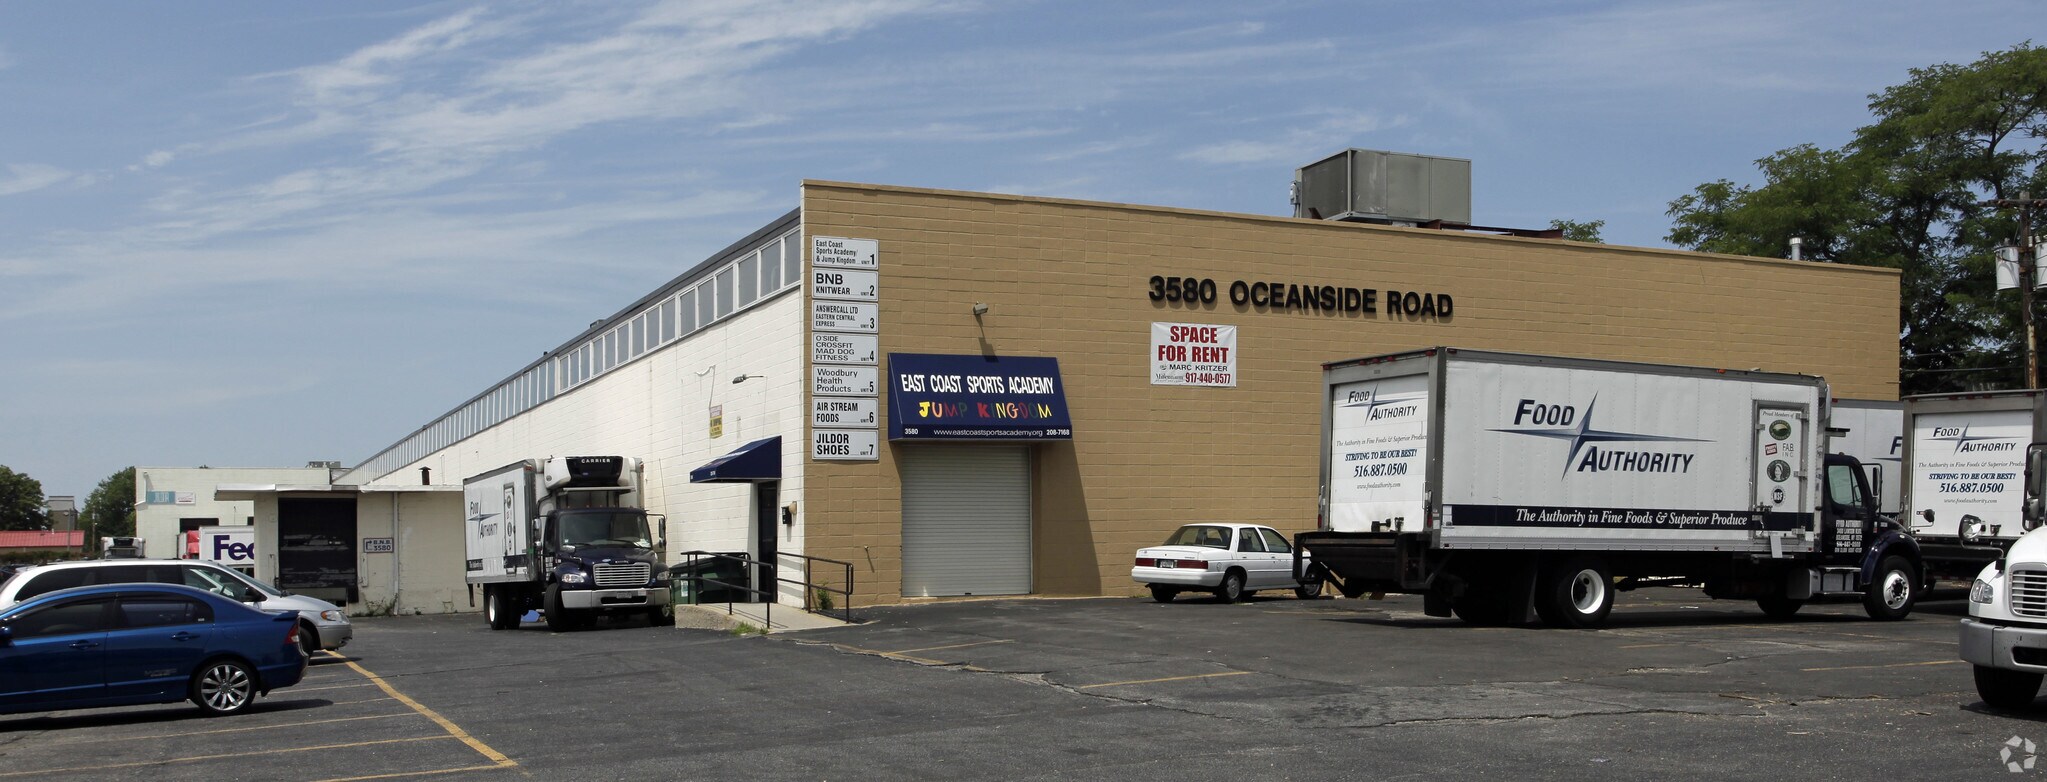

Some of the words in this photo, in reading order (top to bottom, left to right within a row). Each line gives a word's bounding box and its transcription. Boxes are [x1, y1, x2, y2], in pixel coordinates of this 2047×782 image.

[821, 256, 835, 264] Jump
[836, 256, 856, 265] Kingdom
[870, 254, 875, 265] 1
[816, 273, 843, 284] BNB
[816, 286, 850, 295] KNITWEAR
[870, 285, 874, 296] 2
[1149, 275, 1217, 304] 3580
[1230, 280, 1377, 313] OCEANSIDE
[1387, 290, 1454, 318] ROAD
[816, 305, 848, 314] ANSWERCALL
[870, 318, 874, 329] 3
[1170, 326, 1218, 343] SPACE
[870, 351, 874, 361] 4
[1158, 345, 1186, 362] FOR
[1192, 346, 1229, 363] RENT
[817, 368, 858, 378] Woodbury
[869, 381, 874, 392] 5
[901, 374, 926, 392] EAST
[930, 374, 962, 393] COAST
[967, 375, 1004, 394] SPORTS
[1008, 376, 1054, 394] ACADEMY
[1348, 391, 1370, 403] FOOD
[817, 402, 828, 411] AIR
[830, 402, 858, 411] STREAM
[918, 401, 968, 418] JUMP
[977, 402, 1052, 419] KINGDOM
[816, 414, 839, 422] FOODS
[869, 412, 874, 423] 6
[1370, 406, 1417, 420] AUTHORITY
[1513, 399, 1575, 426] FOOD
[1933, 427, 1959, 437] FOOD
[816, 434, 849, 444] JILDOR
[817, 445, 849, 455] SHOES
[869, 444, 874, 455] 7
[1961, 442, 2016, 452] AUTHORITY
[1345, 452, 1369, 461] STRIVING
[1388, 450, 1400, 458] OUR
[1401, 449, 1417, 457] BEST!
[1577, 445, 1694, 473] AUTHORITY
[1354, 462, 1407, 477] 516.887.0500
[1939, 483, 2004, 493] 516.887.0500
[1516, 509, 1536, 522] The
[1538, 510, 1586, 526] Authority
[1588, 511, 1598, 523] in
[1601, 511, 1623, 523] Fine
[1624, 511, 1653, 524] Foods
[1656, 512, 1668, 524] &
[1669, 513, 1709, 528] Superior
[1711, 513, 1747, 525] Produce
